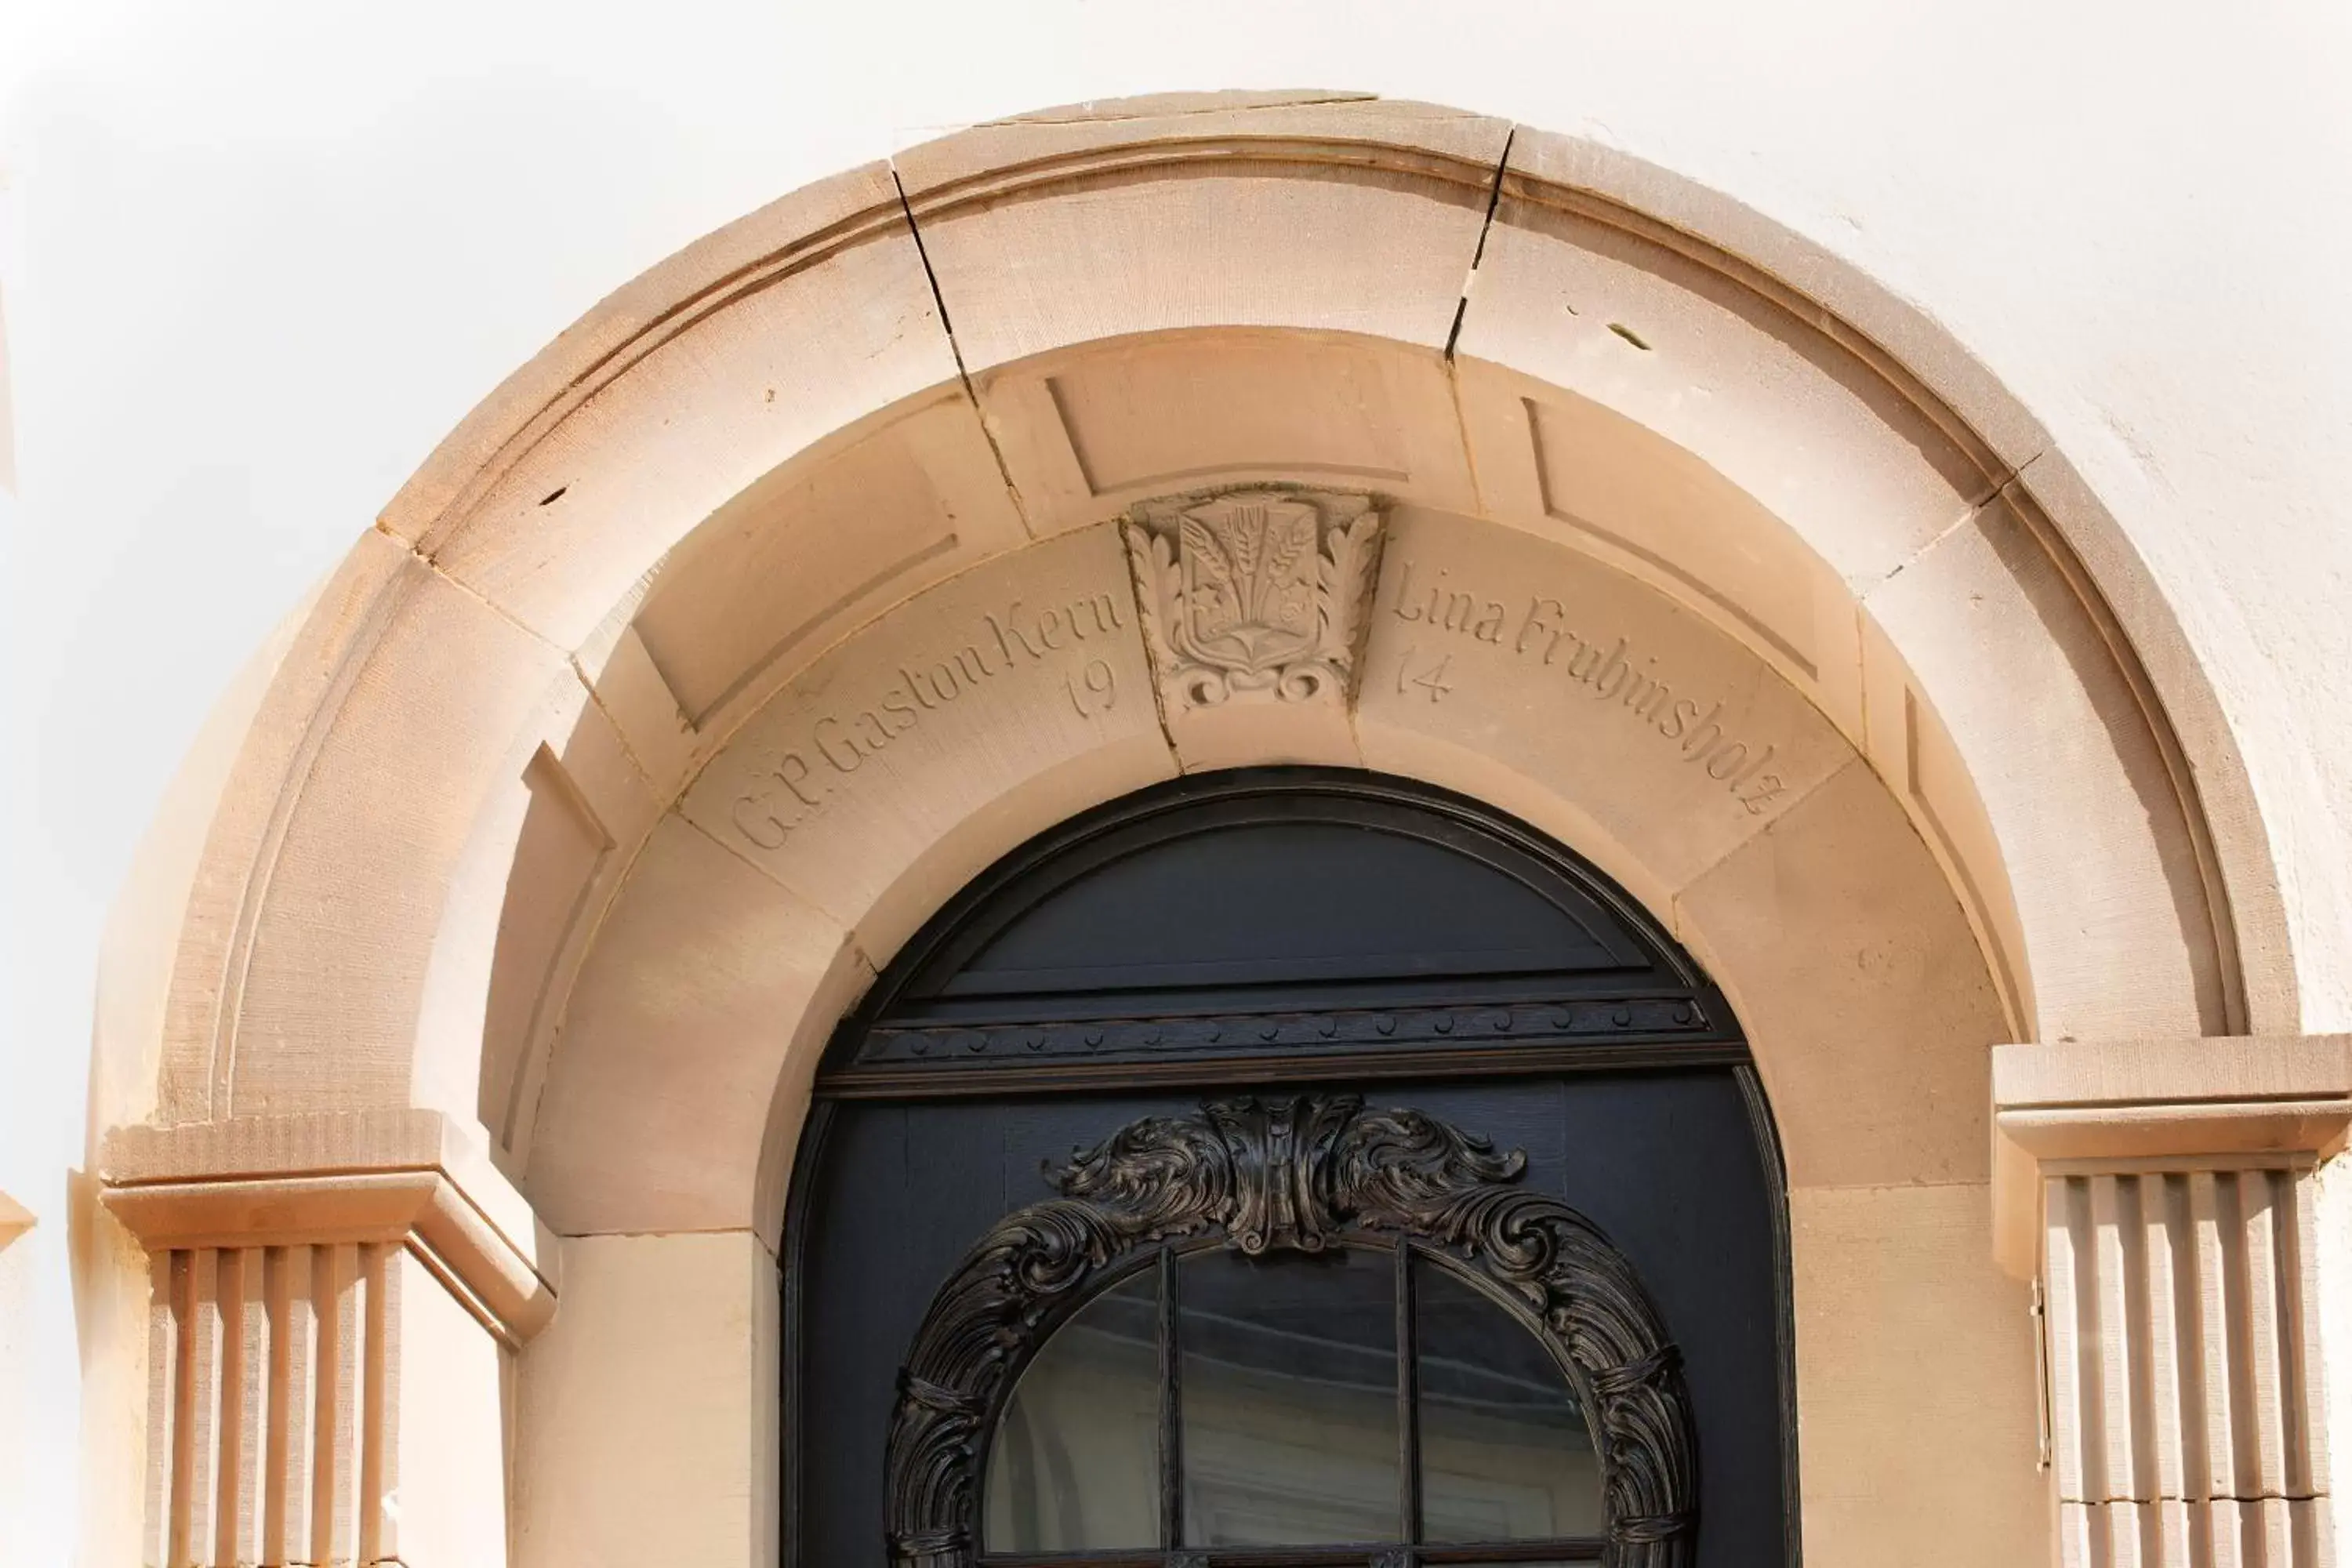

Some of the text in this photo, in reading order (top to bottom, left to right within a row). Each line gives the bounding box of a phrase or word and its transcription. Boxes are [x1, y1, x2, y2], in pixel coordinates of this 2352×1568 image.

[1392, 560, 1505, 644] Lina
[813, 644, 993, 773] Gaston
[983, 590, 1124, 668] Kern
[1058, 659, 1116, 719] 19
[1394, 645, 1454, 703] 14
